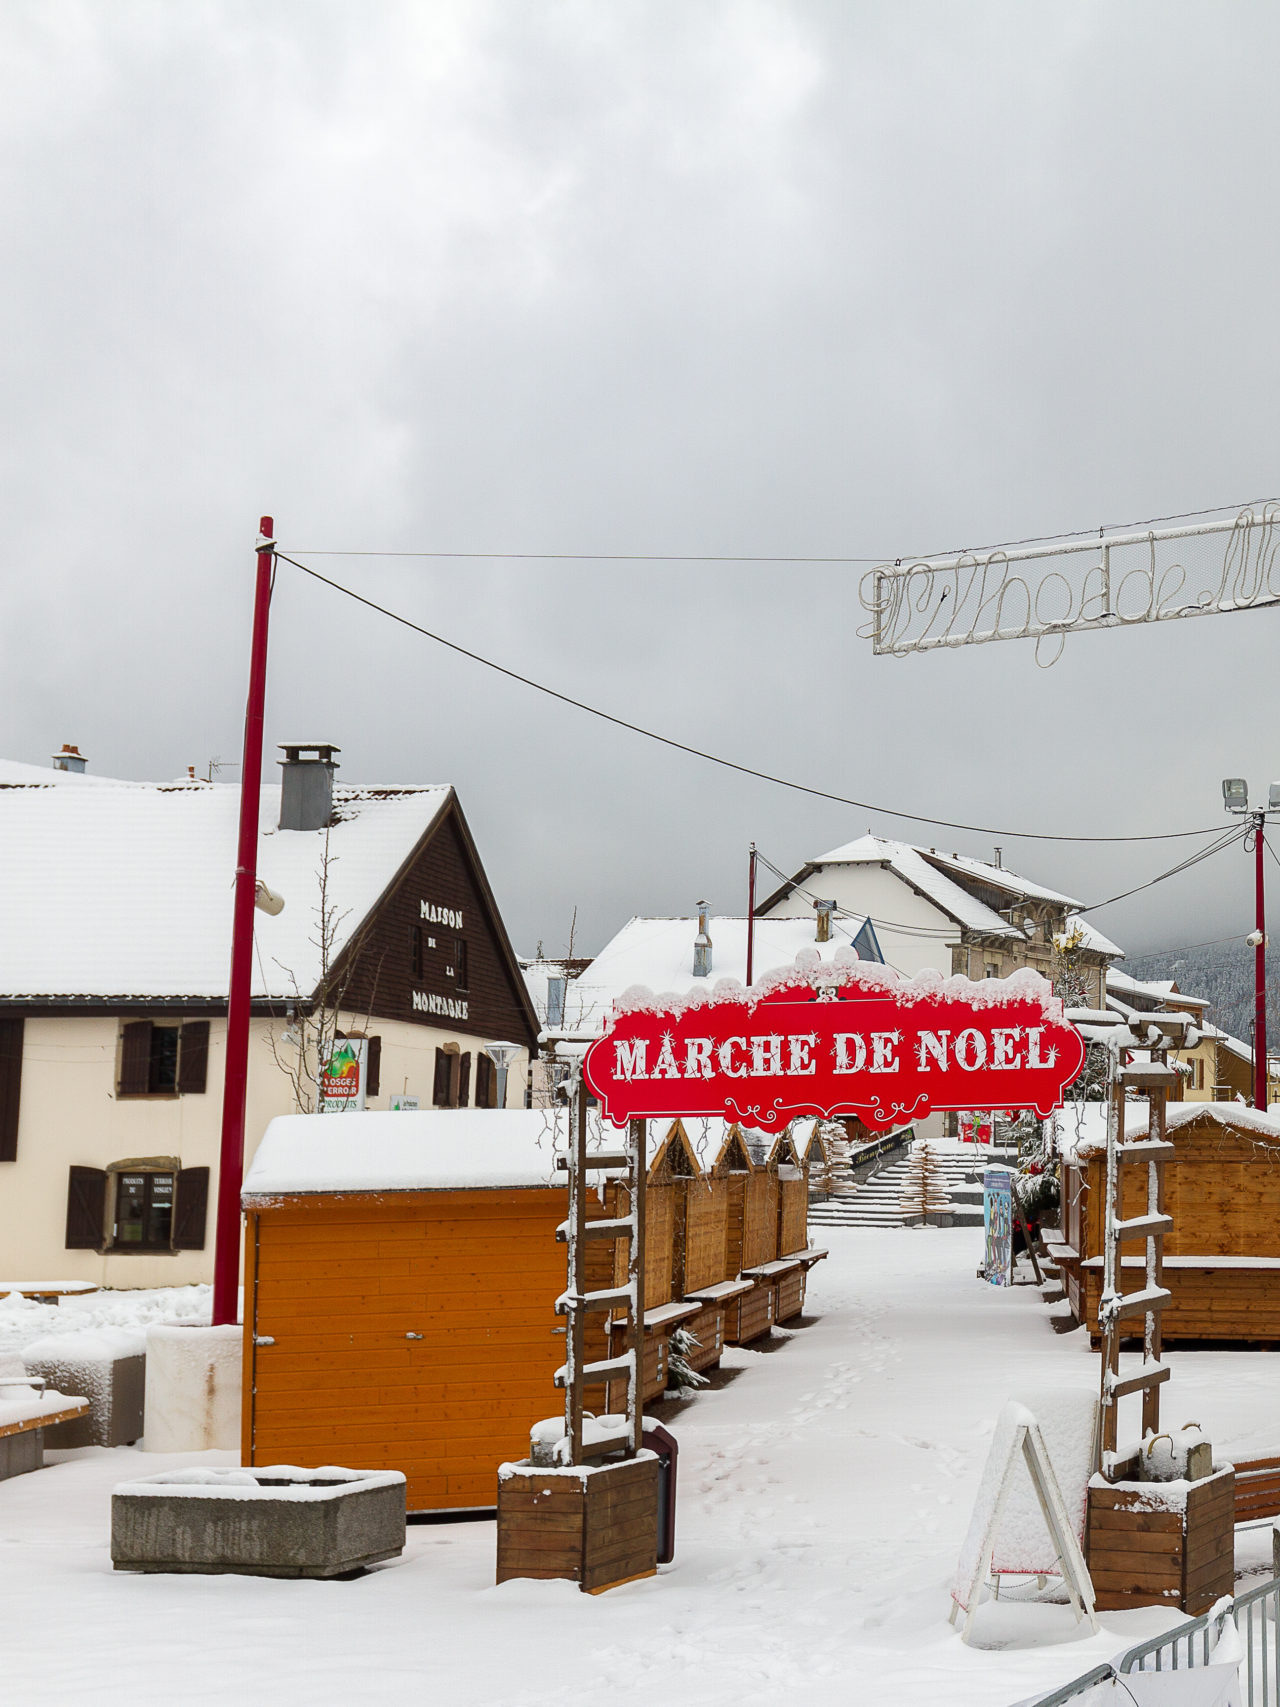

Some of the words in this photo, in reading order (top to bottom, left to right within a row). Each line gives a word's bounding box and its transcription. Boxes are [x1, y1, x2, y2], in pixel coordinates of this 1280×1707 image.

[420, 899, 463, 930] MAISON
[427, 937, 437, 948] DE
[445, 966, 455, 977] LA
[412, 990, 469, 1020] MONTAGNE
[611, 1031, 819, 1083] MARCHE
[831, 1029, 902, 1075] DE
[914, 1024, 1060, 1072] NOEL
